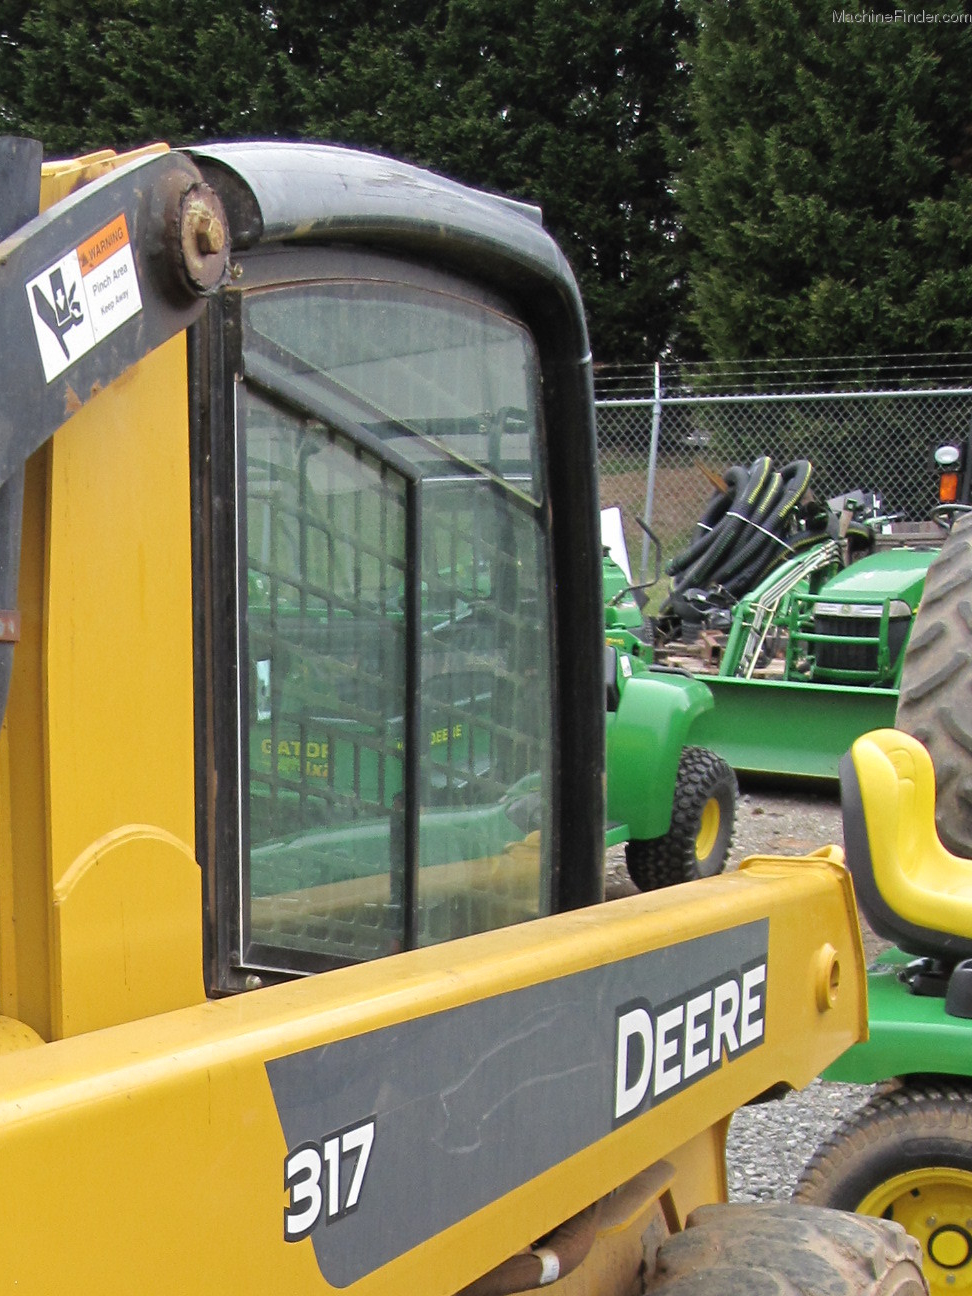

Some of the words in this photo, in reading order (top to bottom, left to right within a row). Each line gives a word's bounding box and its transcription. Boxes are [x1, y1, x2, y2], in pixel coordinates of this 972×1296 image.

[88, 227, 124, 260] WARNING
[92, 276, 112, 296] Pinch
[113, 264, 128, 280] Area
[100, 301, 115, 315] Keep
[115, 289, 129, 304] Away
[615, 964, 767, 1119] DEERE
[287, 1121, 376, 1235] 317
